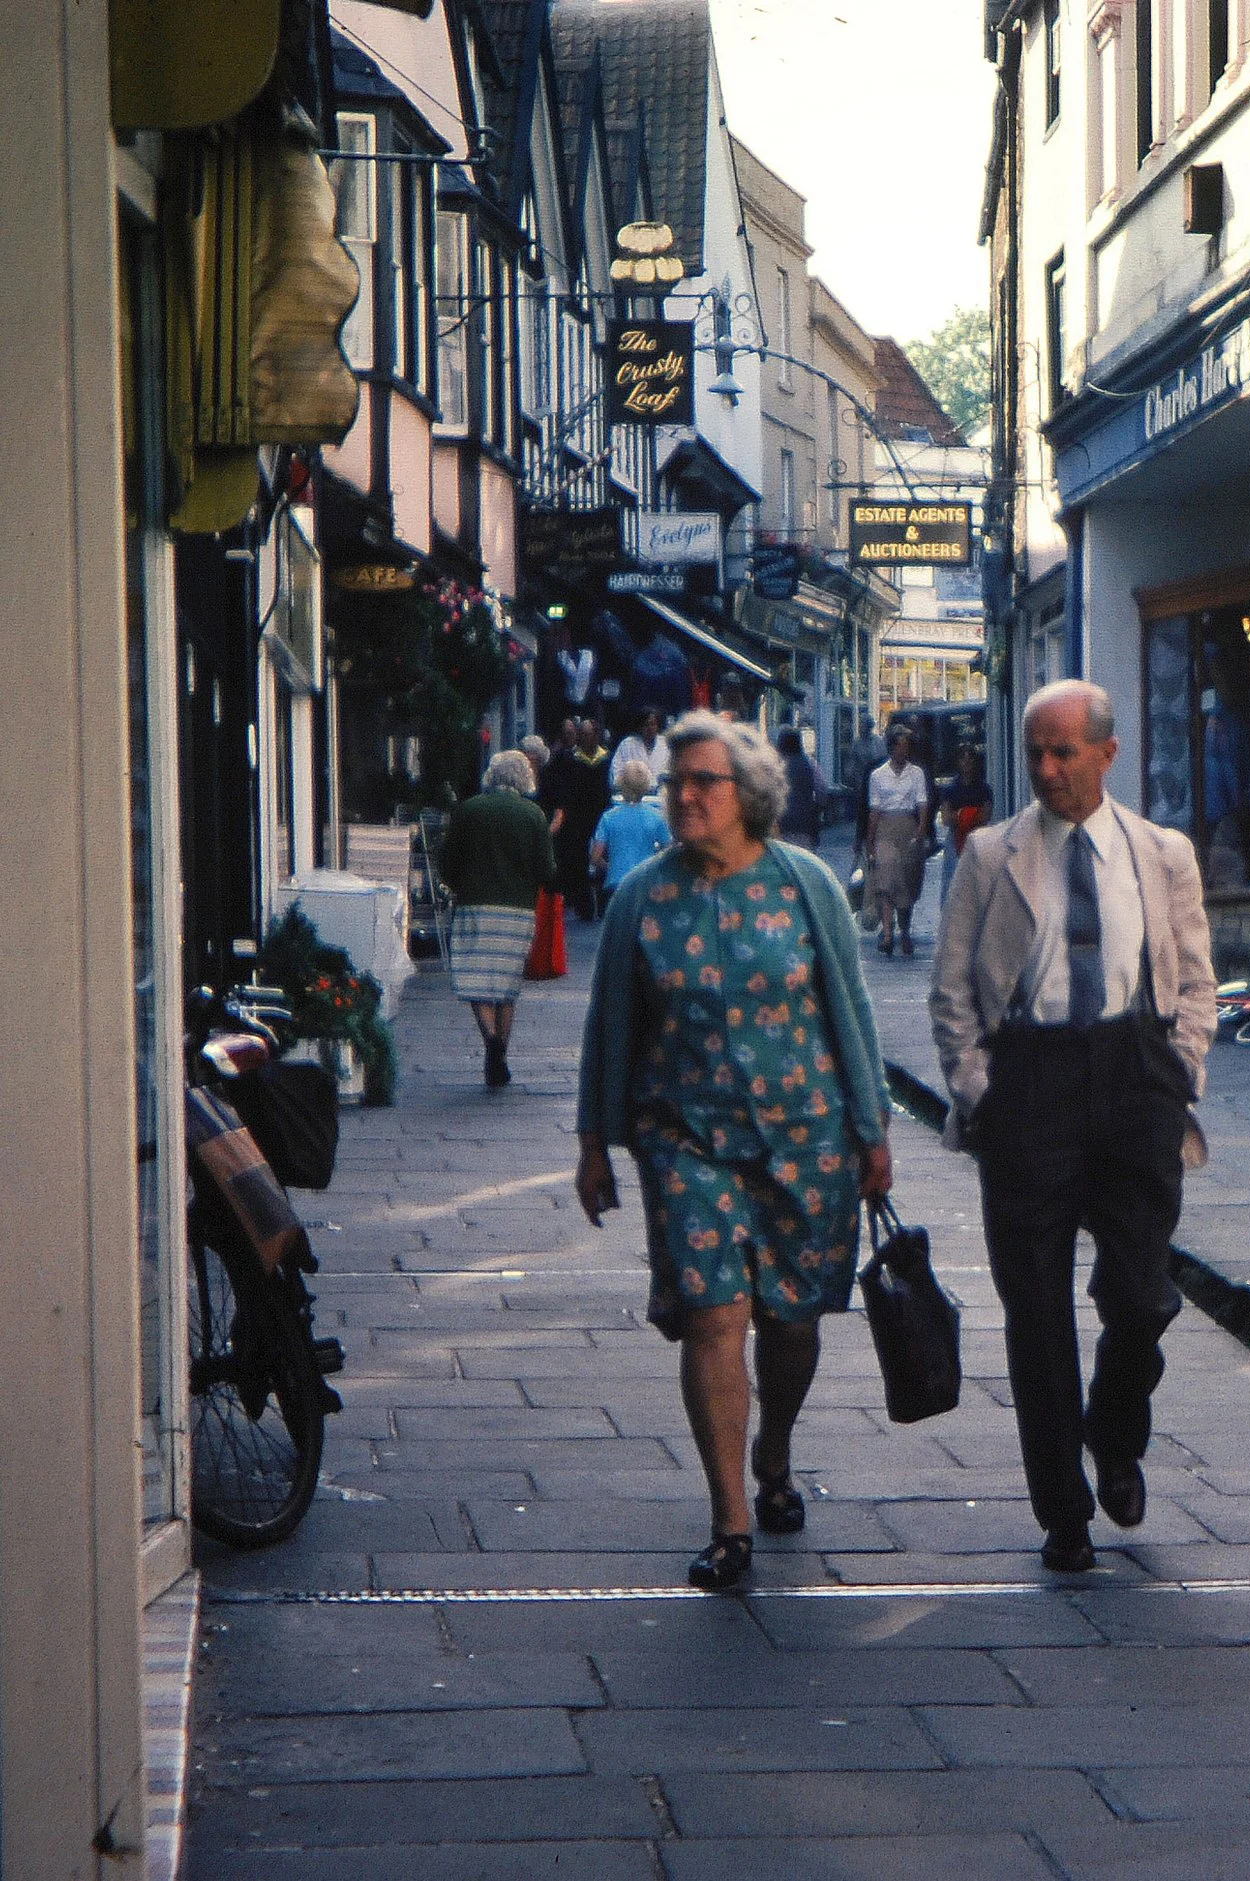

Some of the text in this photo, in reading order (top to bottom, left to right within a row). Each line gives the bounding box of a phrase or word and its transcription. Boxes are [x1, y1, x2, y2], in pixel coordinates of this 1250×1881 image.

[618, 330, 657, 351] The
[617, 351, 684, 385] Crusty
[624, 381, 680, 413] Loaf
[1145, 368, 1197, 440] Charles
[855, 507, 967, 524] ESTATE AGENTS
[905, 525, 921, 541] &
[860, 543, 962, 559] AUCTIONEERS
